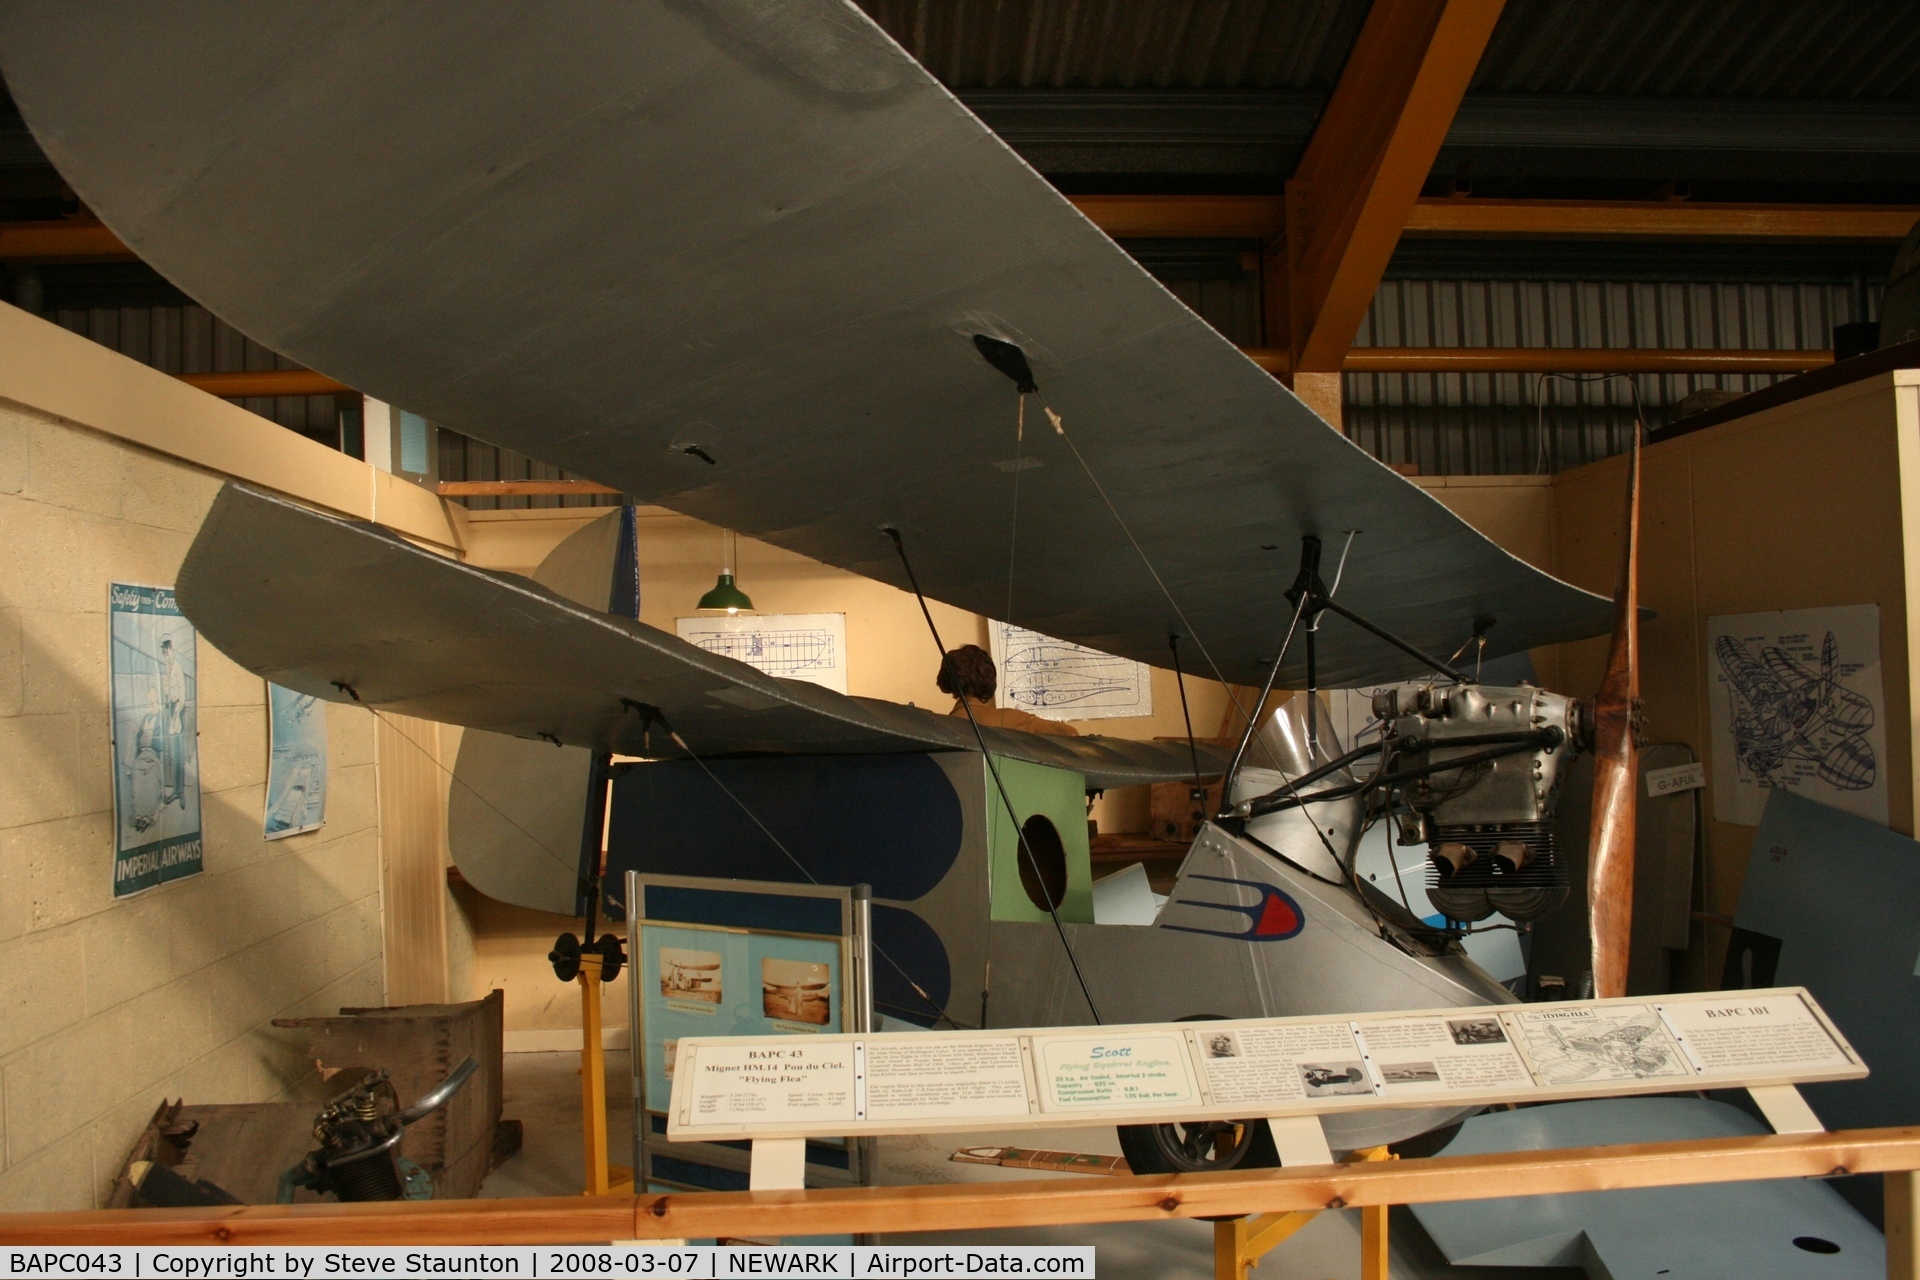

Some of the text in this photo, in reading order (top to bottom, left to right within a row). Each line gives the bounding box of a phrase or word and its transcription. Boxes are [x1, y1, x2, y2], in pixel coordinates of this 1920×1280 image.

[112, 586, 140, 611] Safety
[117, 840, 201, 882] IMPERIAL AIRWAYS
[1704, 1006, 1770, 1018] BAPC 101
[748, 1050, 803, 1059] BAPC 43
[1090, 1046, 1132, 1058] Scott
[705, 1064, 740, 1073] Mignet
[1059, 1062, 1090, 1071] Flying
[1092, 1060, 1132, 1070] Squirrel
[738, 1074, 808, 1084] "Flying Flea"
